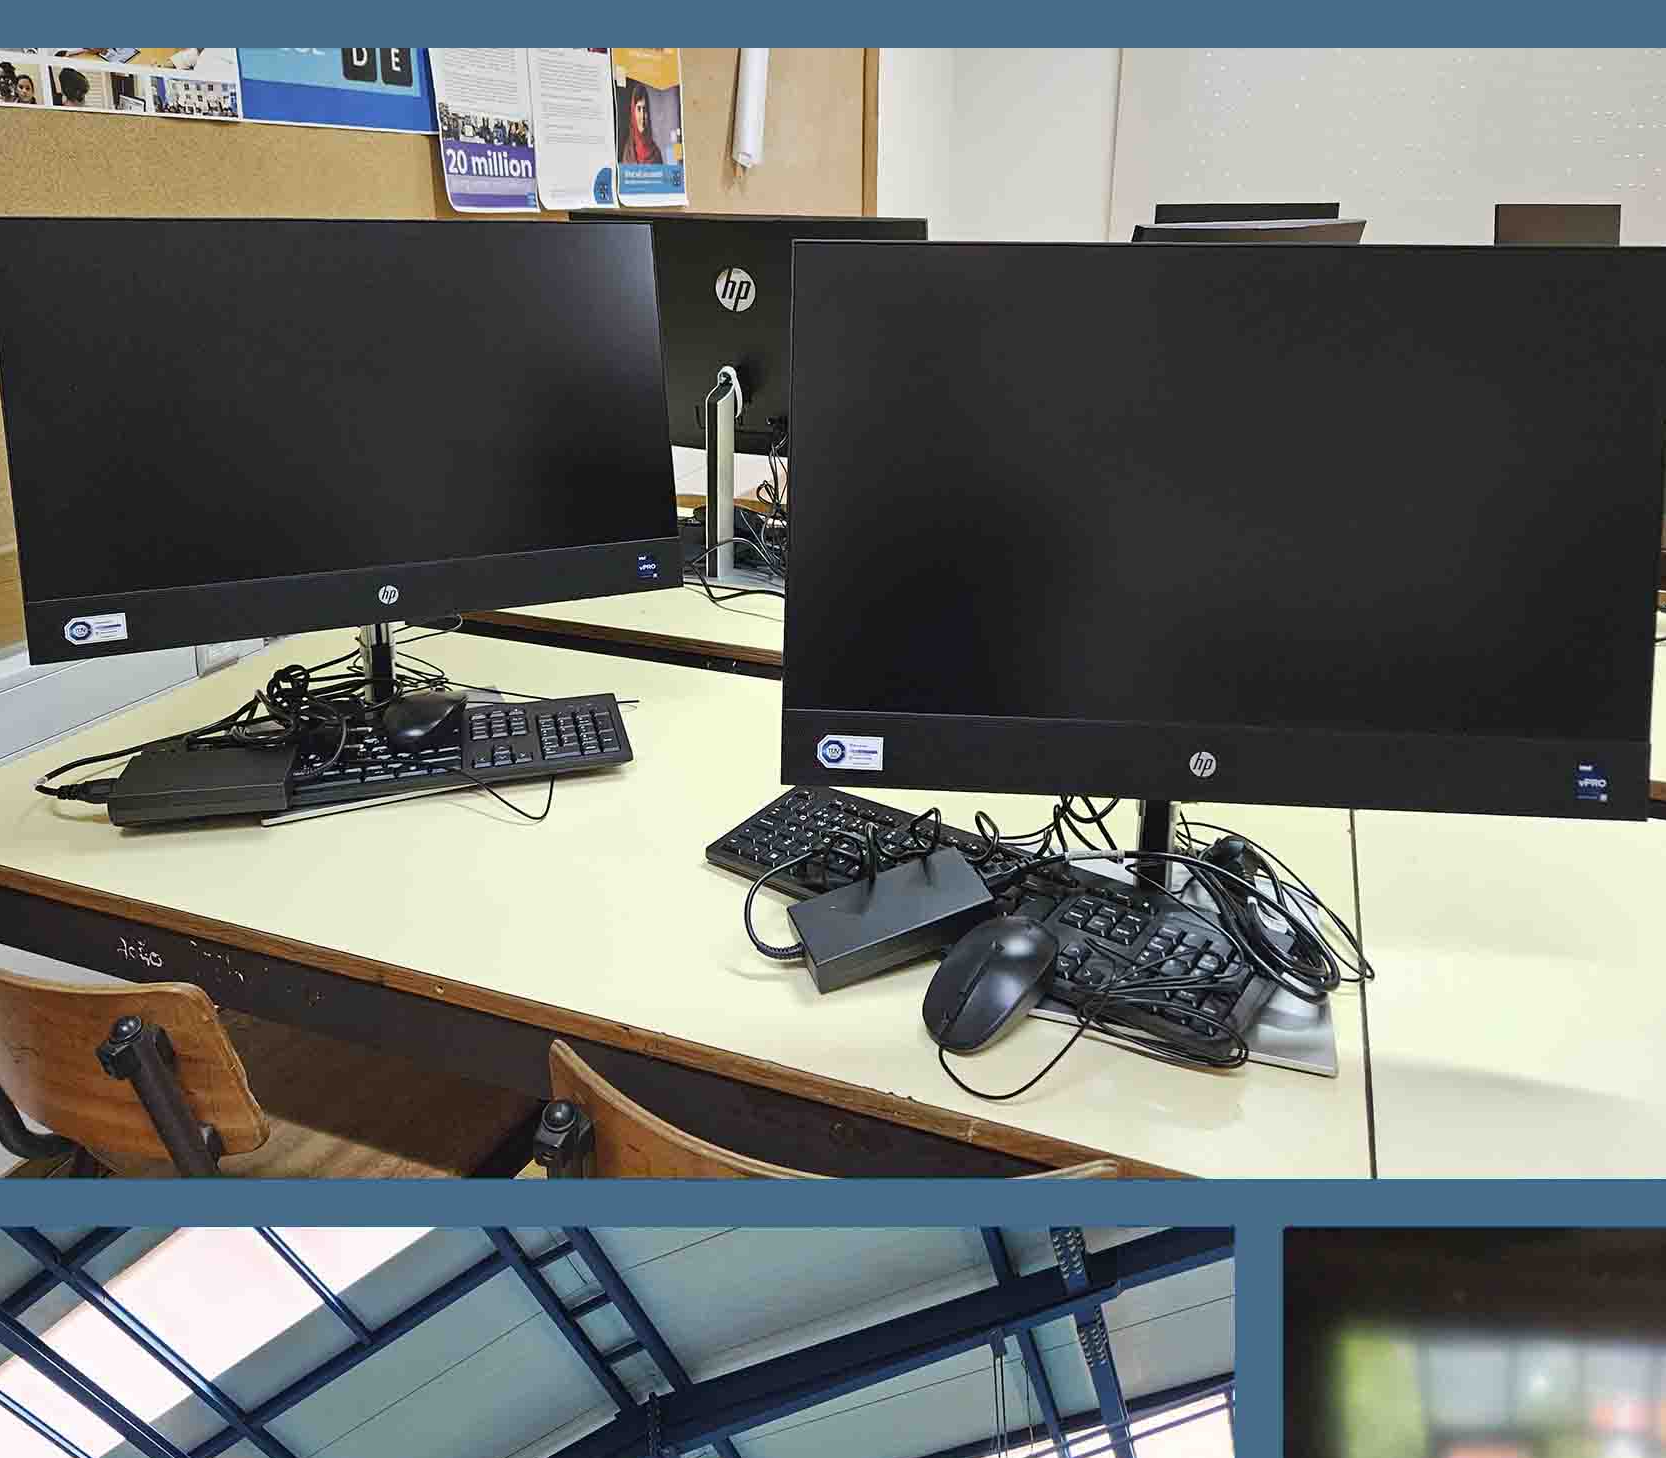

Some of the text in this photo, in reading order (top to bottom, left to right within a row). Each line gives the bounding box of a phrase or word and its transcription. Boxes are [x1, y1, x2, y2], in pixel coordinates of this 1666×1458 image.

[446, 150, 533, 178] 20 million
[721, 268, 752, 311] hp
[380, 586, 398, 604] hp
[1191, 752, 1215, 776] hp
